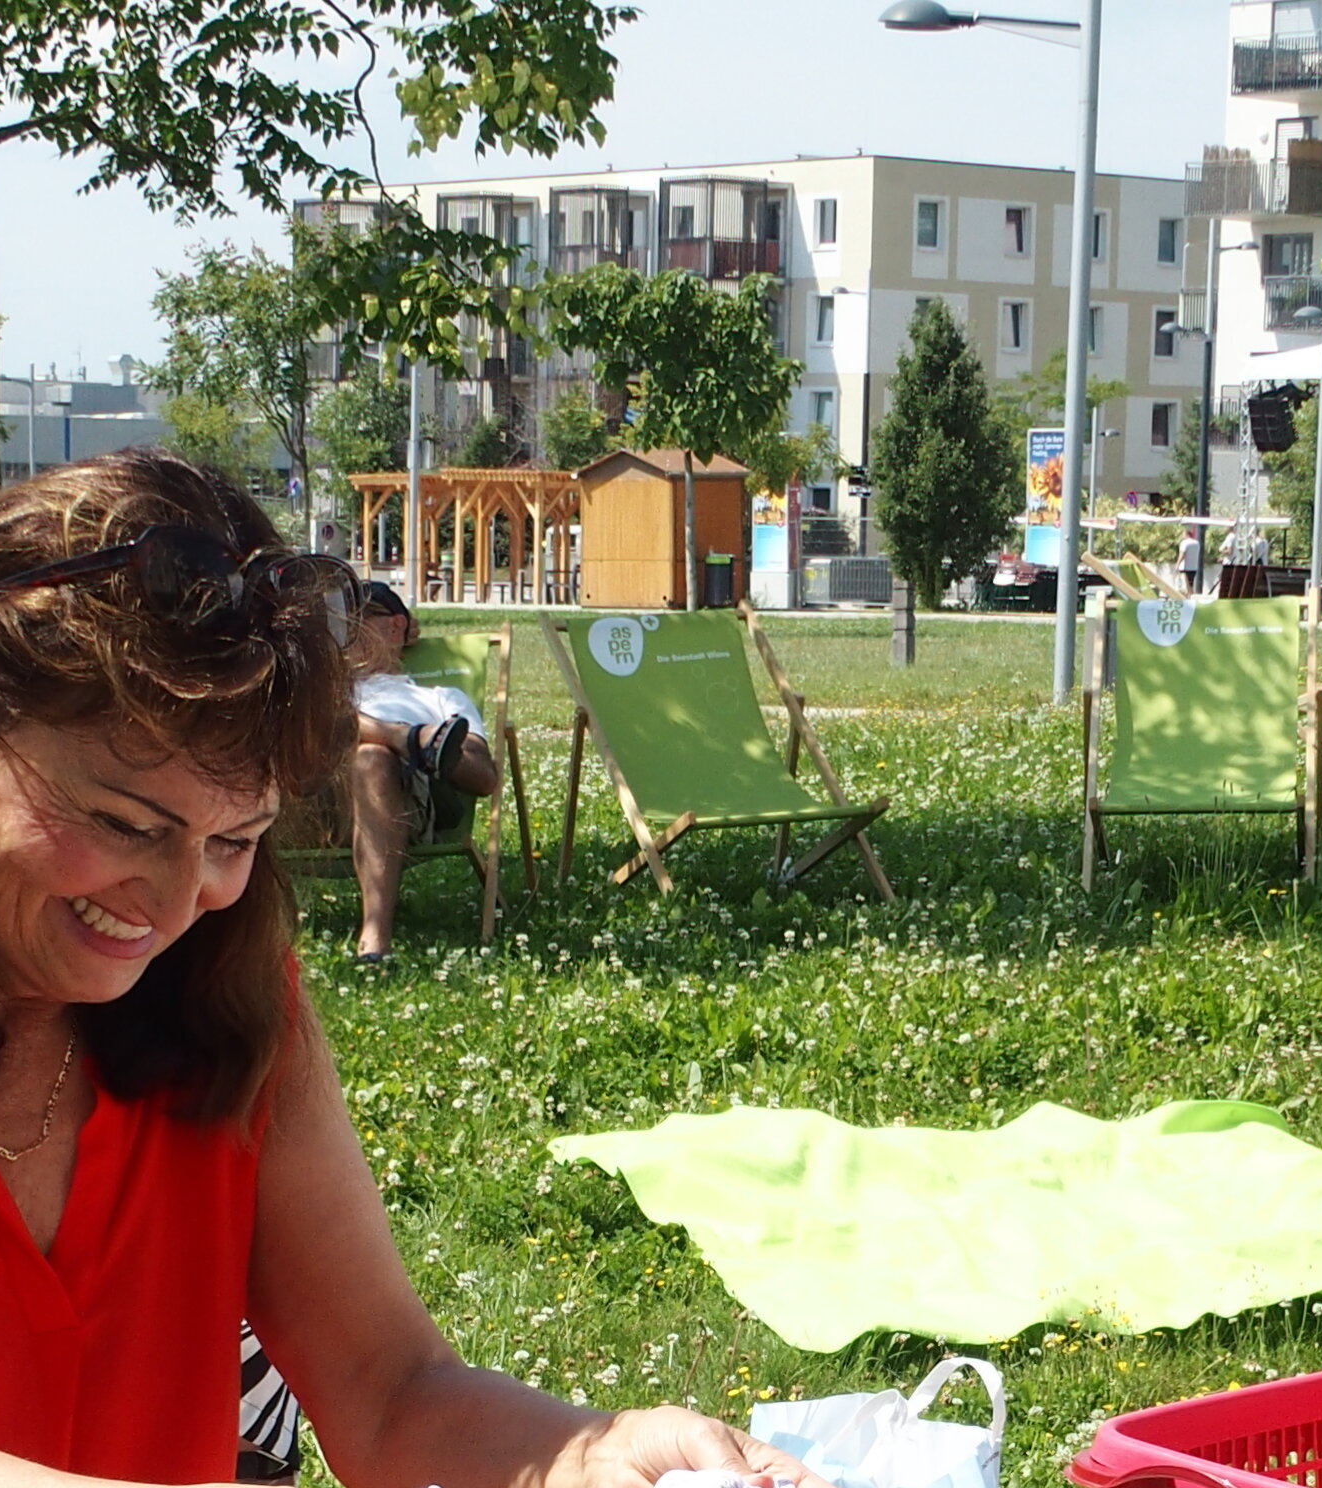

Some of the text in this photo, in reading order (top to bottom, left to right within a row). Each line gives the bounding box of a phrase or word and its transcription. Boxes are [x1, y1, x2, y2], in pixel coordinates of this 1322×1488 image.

[1157, 609, 1181, 625] pe
[610, 626, 632, 639] as
[1161, 622, 1181, 634] rn
[608, 639, 632, 656] pe
[615, 652, 635, 664] rn
